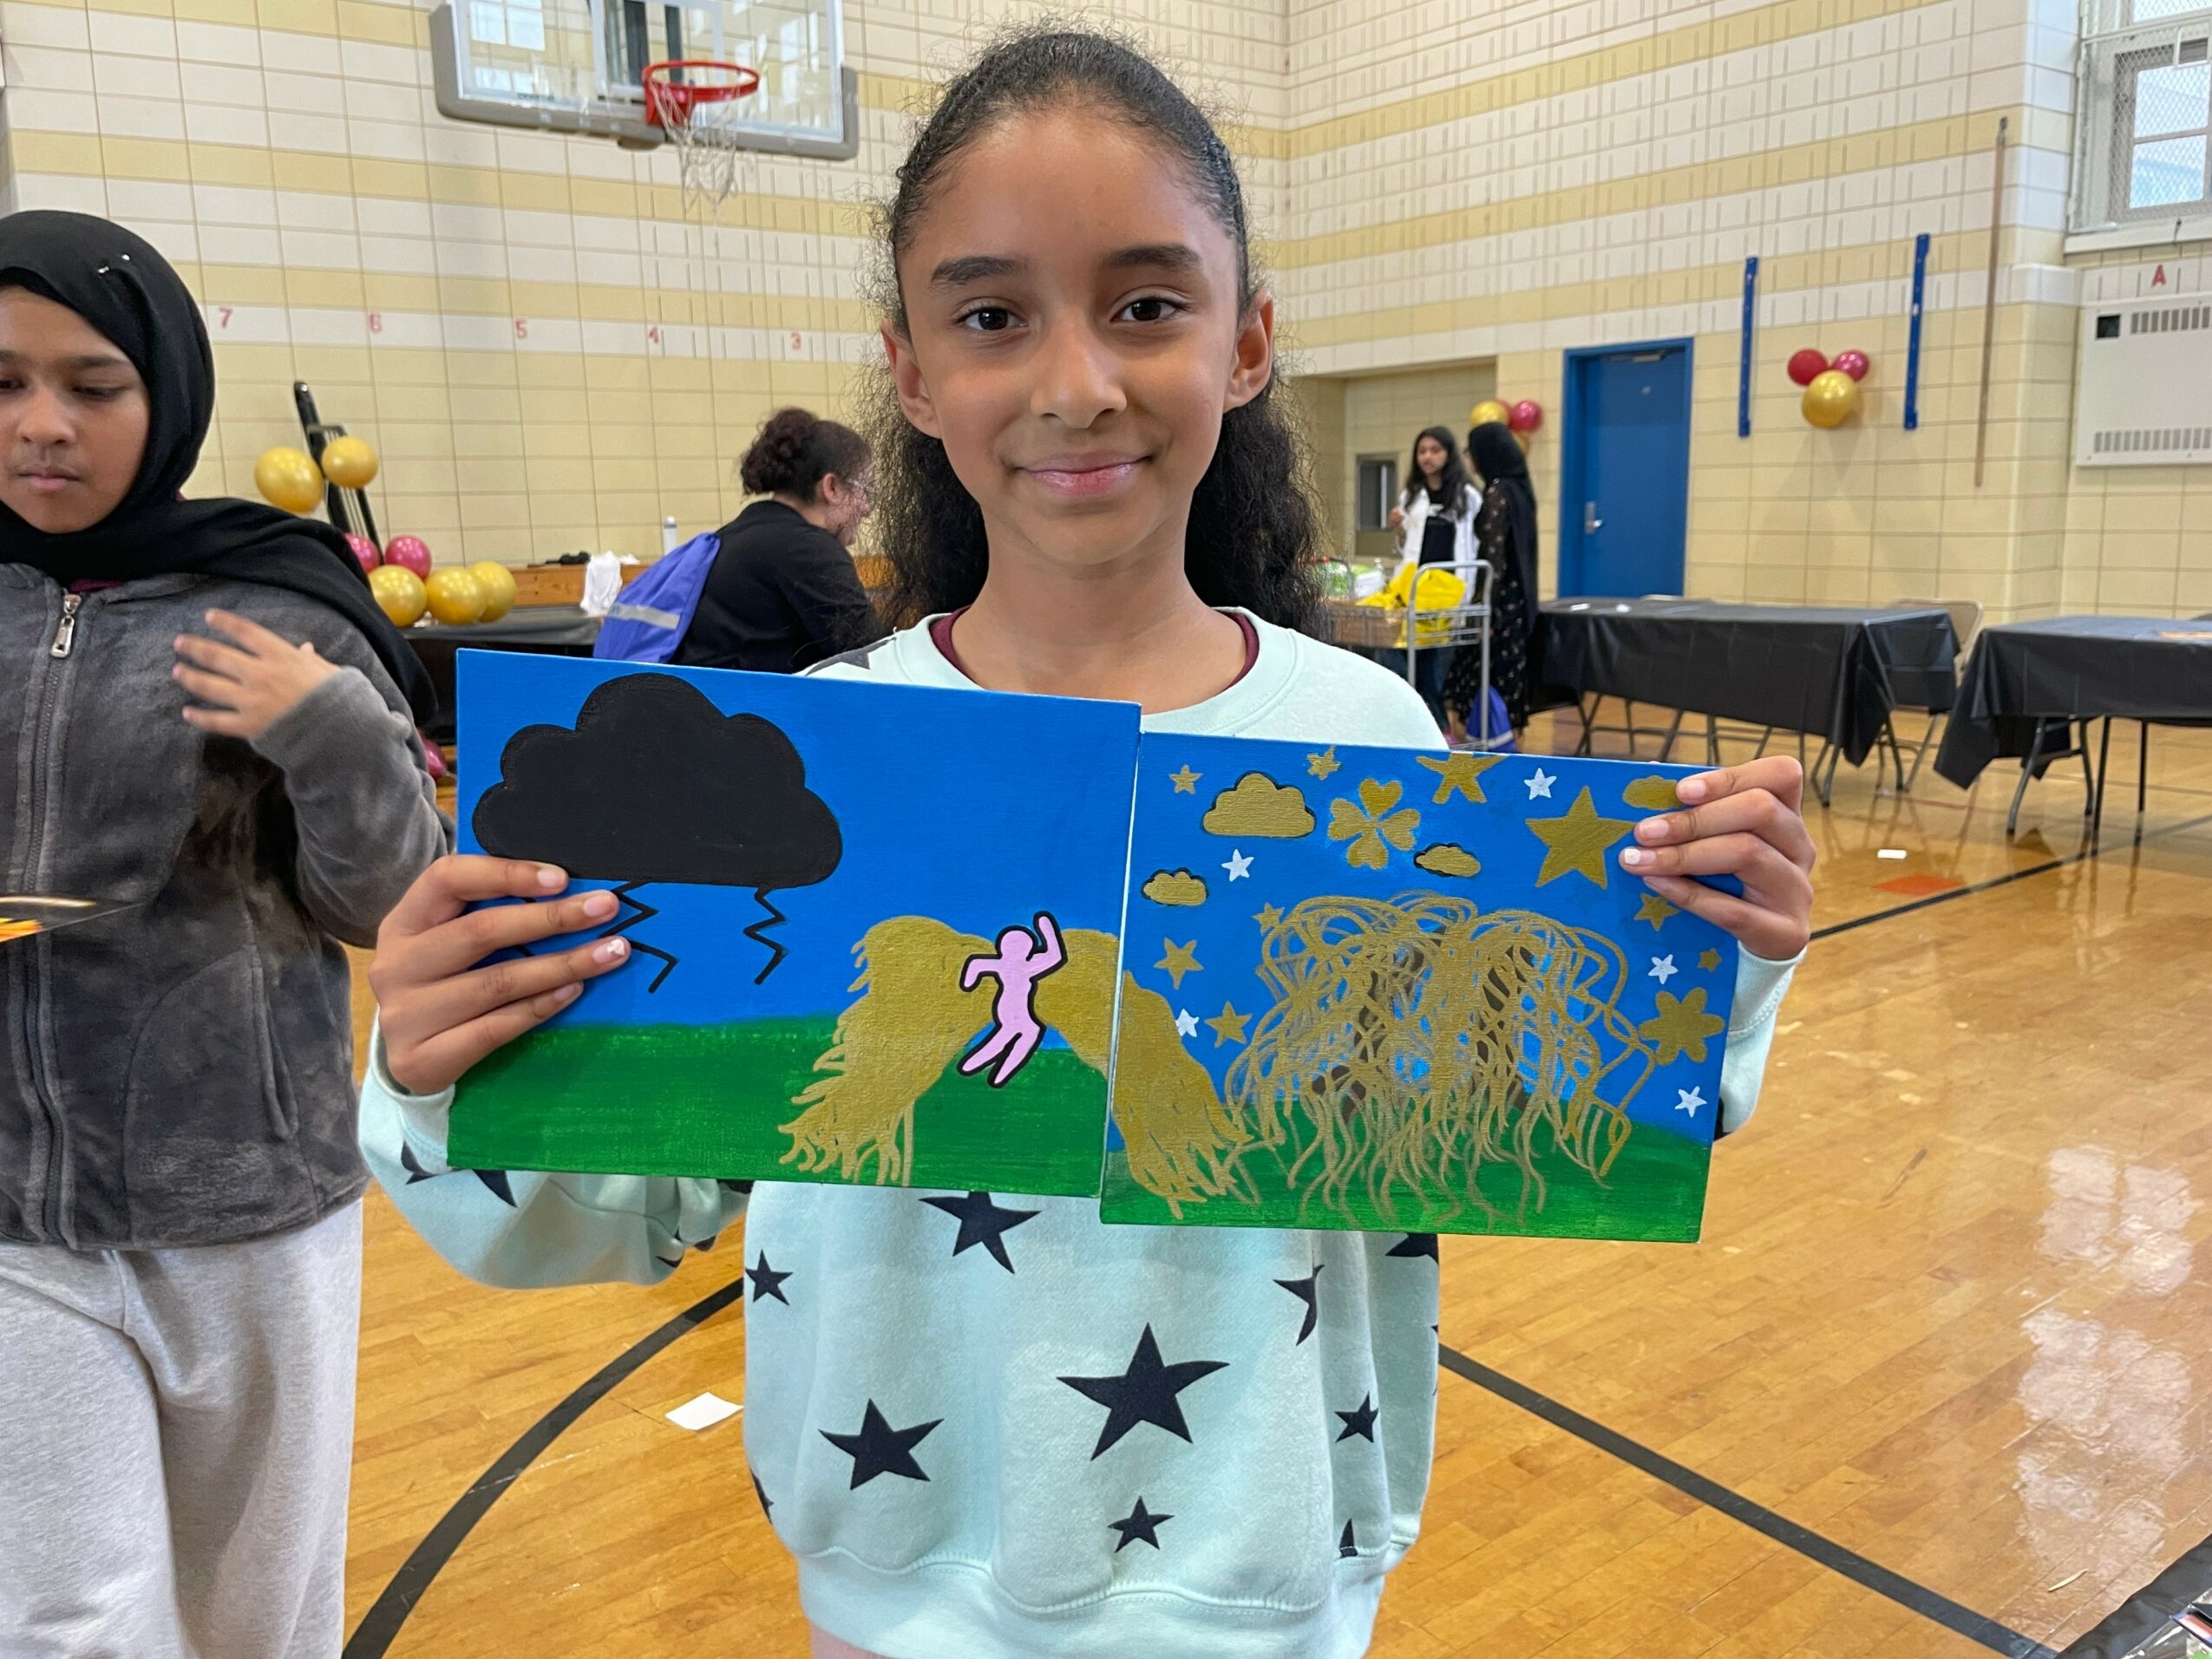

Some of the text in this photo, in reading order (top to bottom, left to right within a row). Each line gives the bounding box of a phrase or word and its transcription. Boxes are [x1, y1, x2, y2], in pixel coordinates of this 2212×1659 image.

[2150, 264, 2167, 287] A
[219, 308, 233, 329] 7
[369, 313, 383, 334] 6
[514, 319, 527, 339] 5
[648, 326, 658, 344] 4
[791, 331, 802, 350] 3
